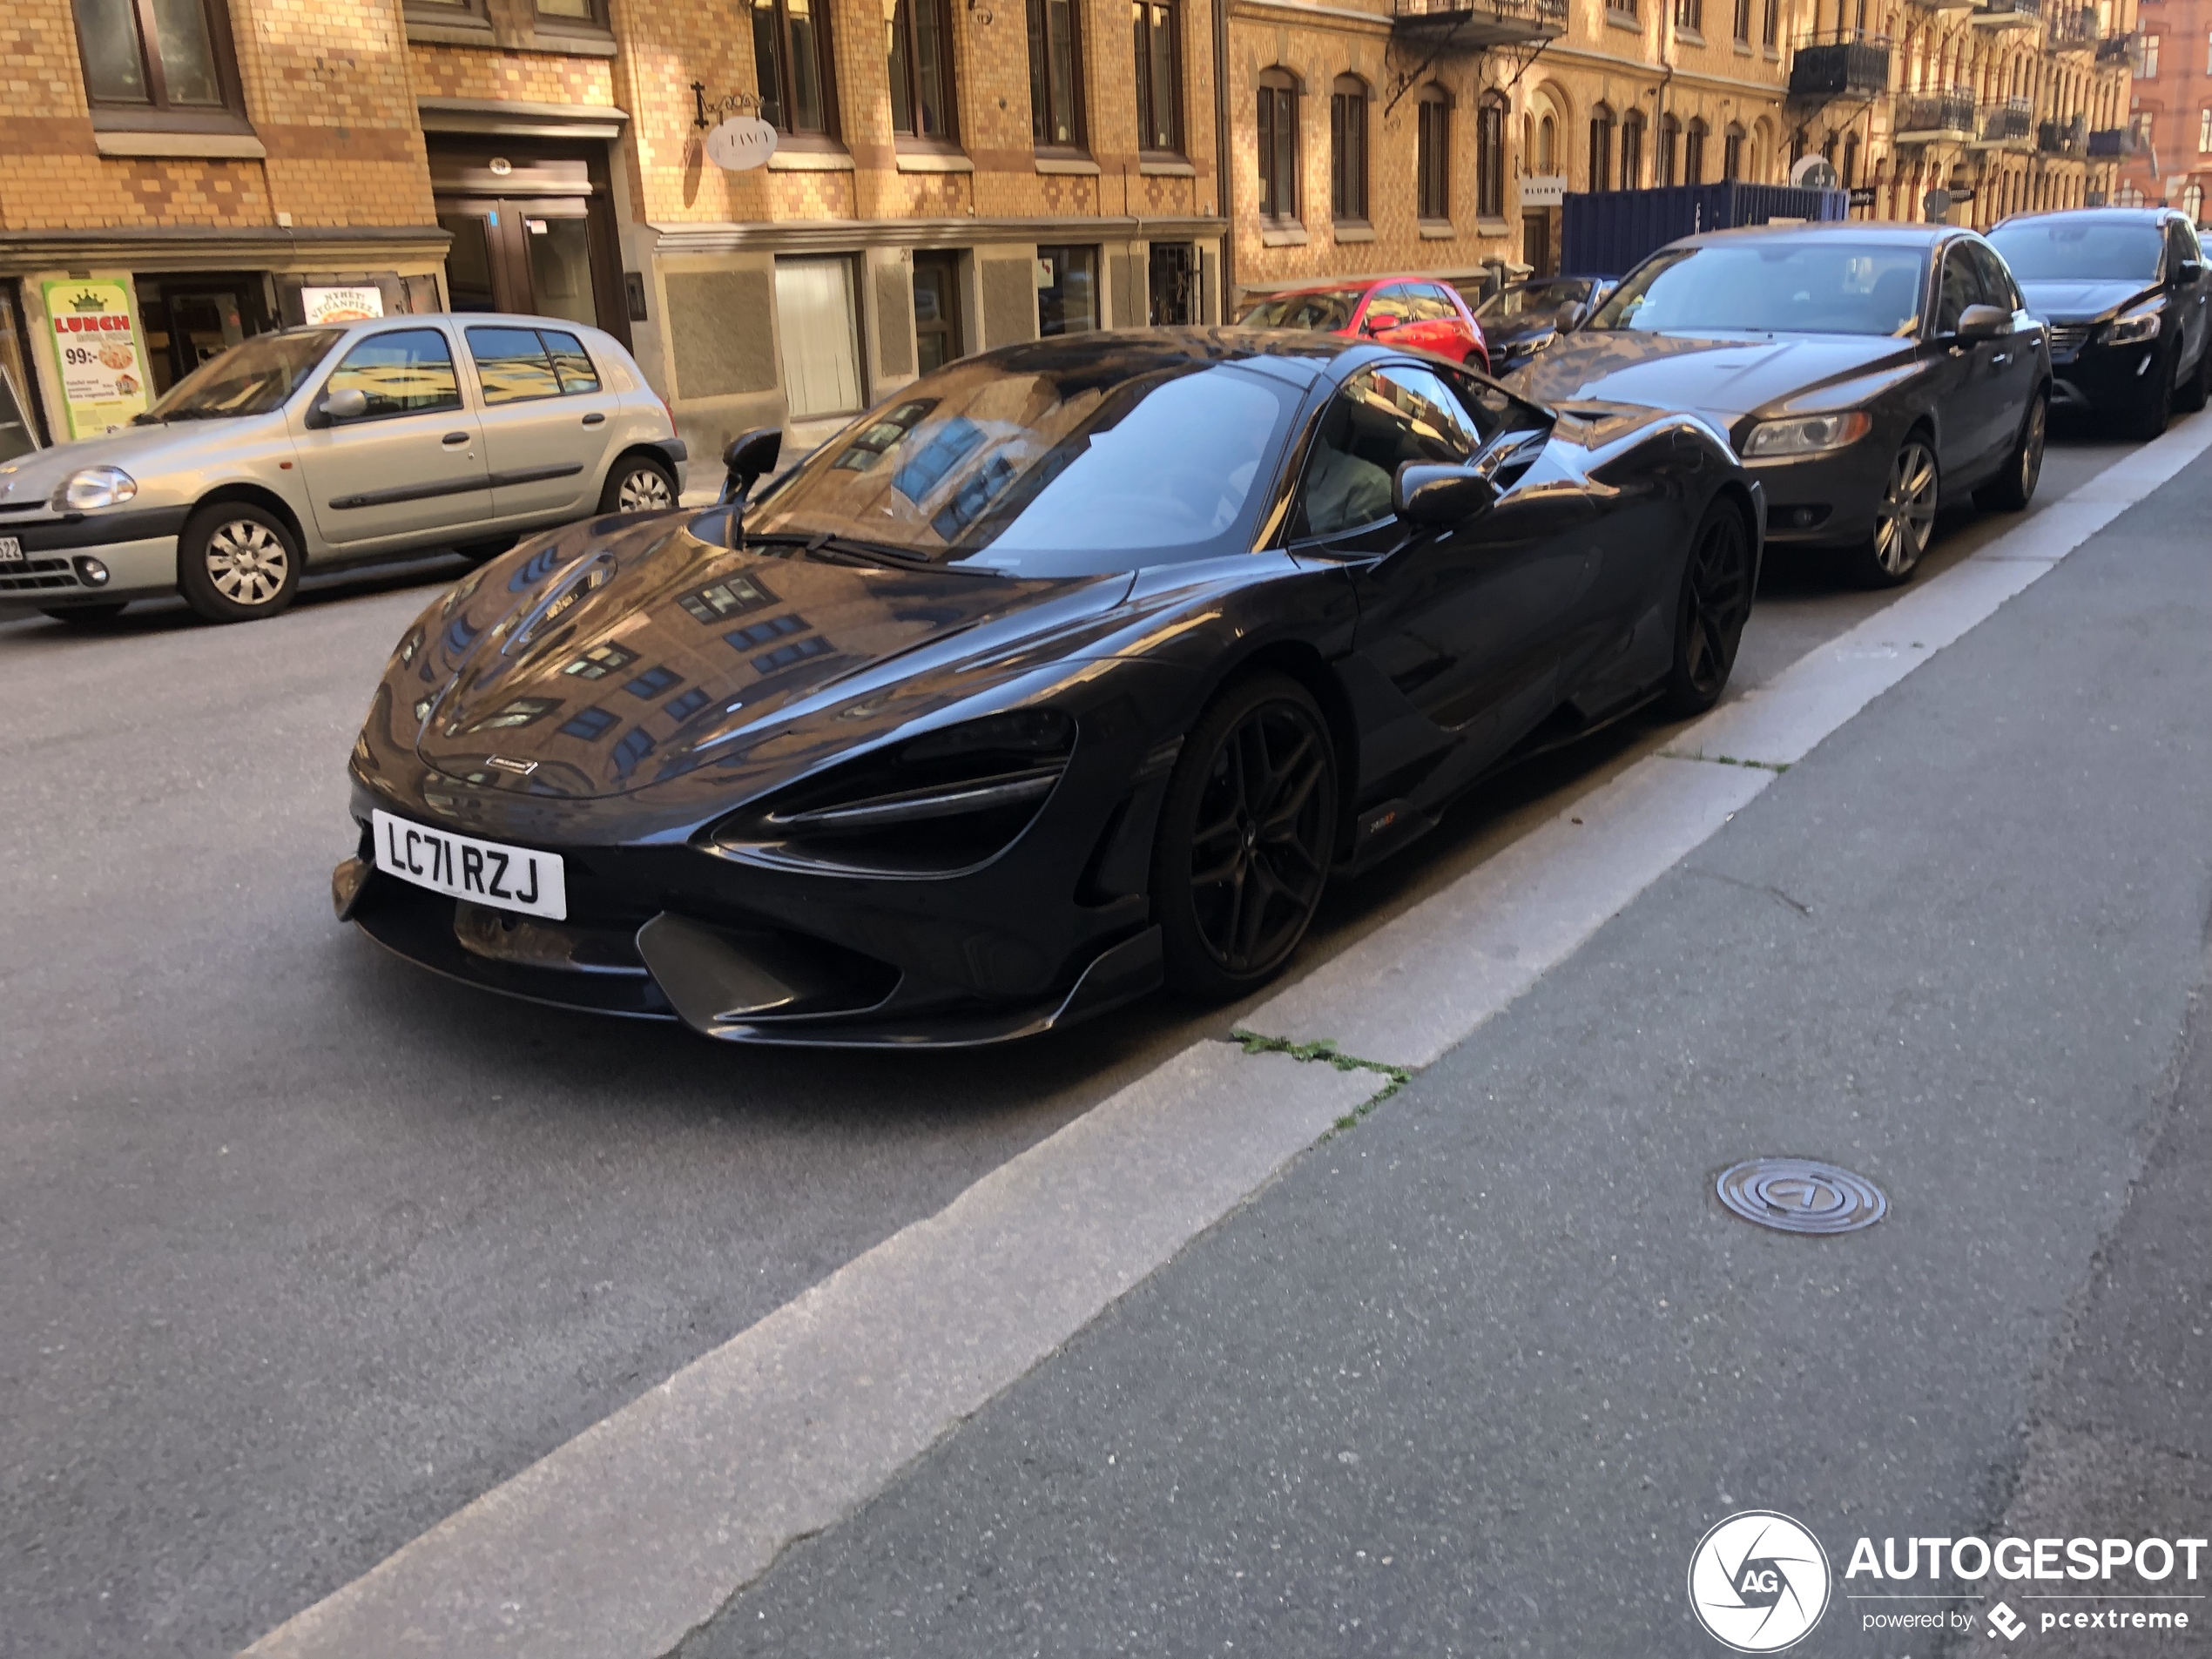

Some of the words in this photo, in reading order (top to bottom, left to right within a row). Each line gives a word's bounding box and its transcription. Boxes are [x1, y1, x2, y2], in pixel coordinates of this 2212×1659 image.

[54, 315, 131, 333] LUNCH
[65, 348, 98, 365] 99:-
[388, 822, 454, 887] LC71
[462, 845, 539, 904] RZJ
